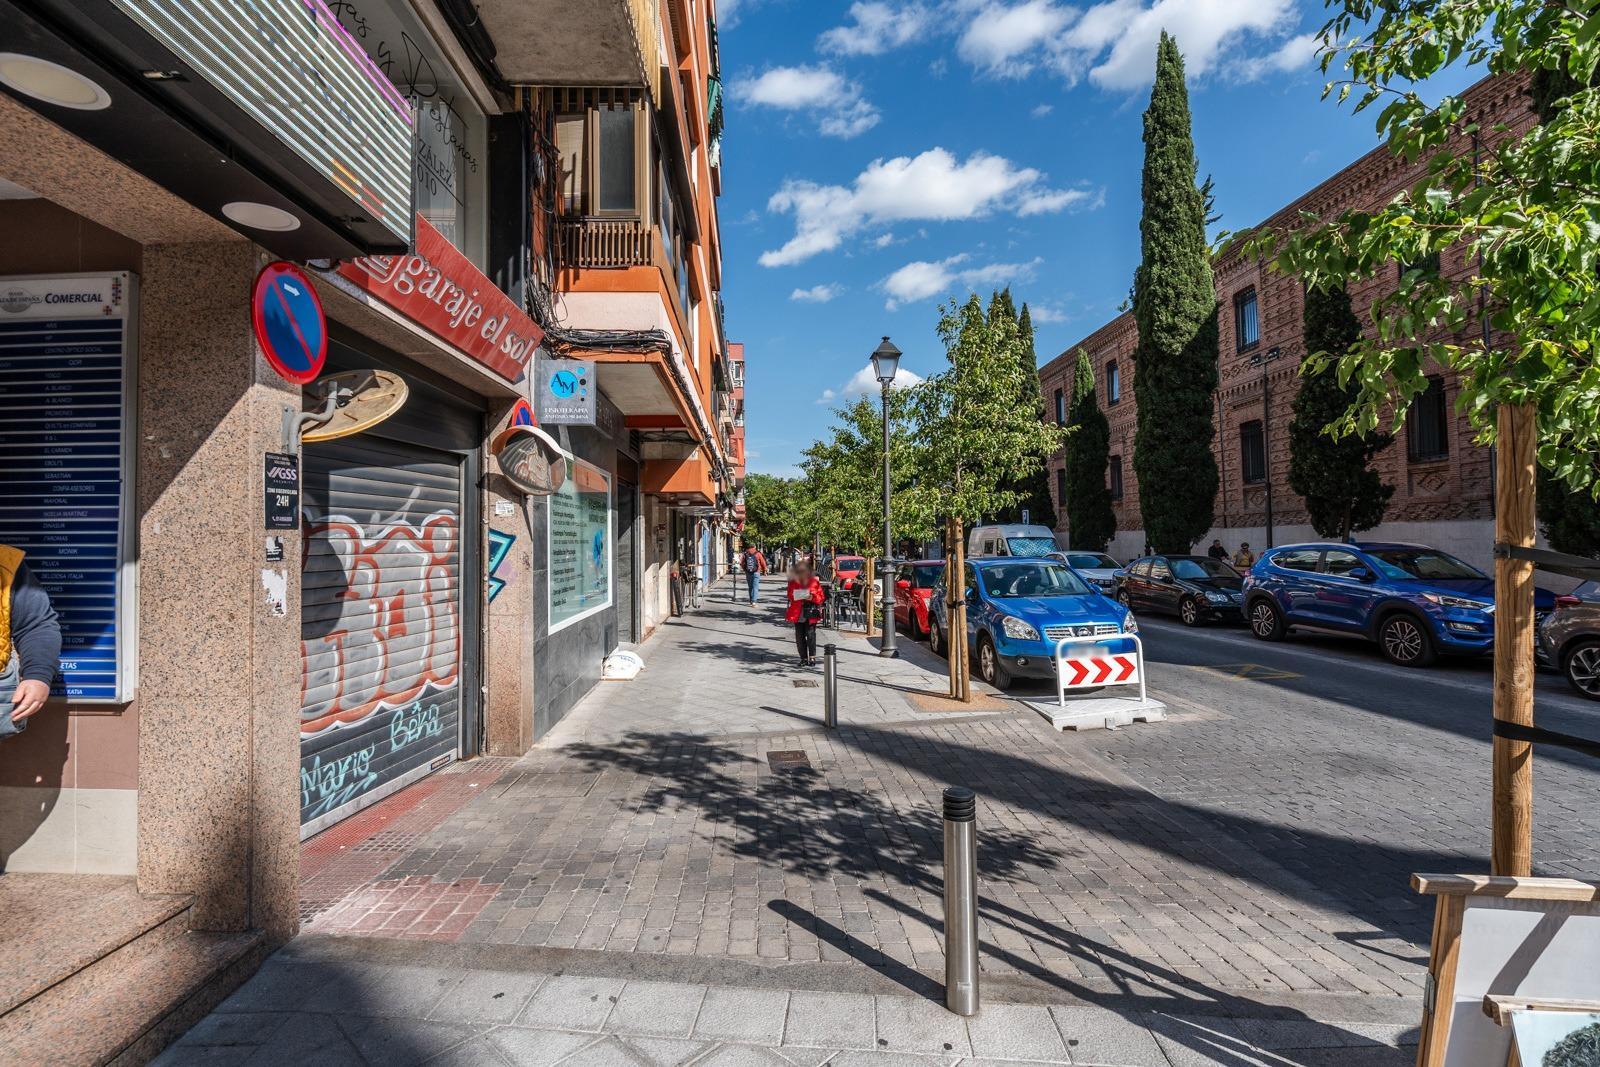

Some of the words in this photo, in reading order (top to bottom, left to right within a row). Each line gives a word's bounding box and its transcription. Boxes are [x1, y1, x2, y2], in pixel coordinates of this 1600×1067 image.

[45, 293, 103, 304] COMERCIAL
[394, 255, 484, 329] garaje
[481, 313, 510, 345] el
[501, 330, 536, 365] sol
[279, 467, 297, 481] GSS
[276, 494, 289, 507] 24H
